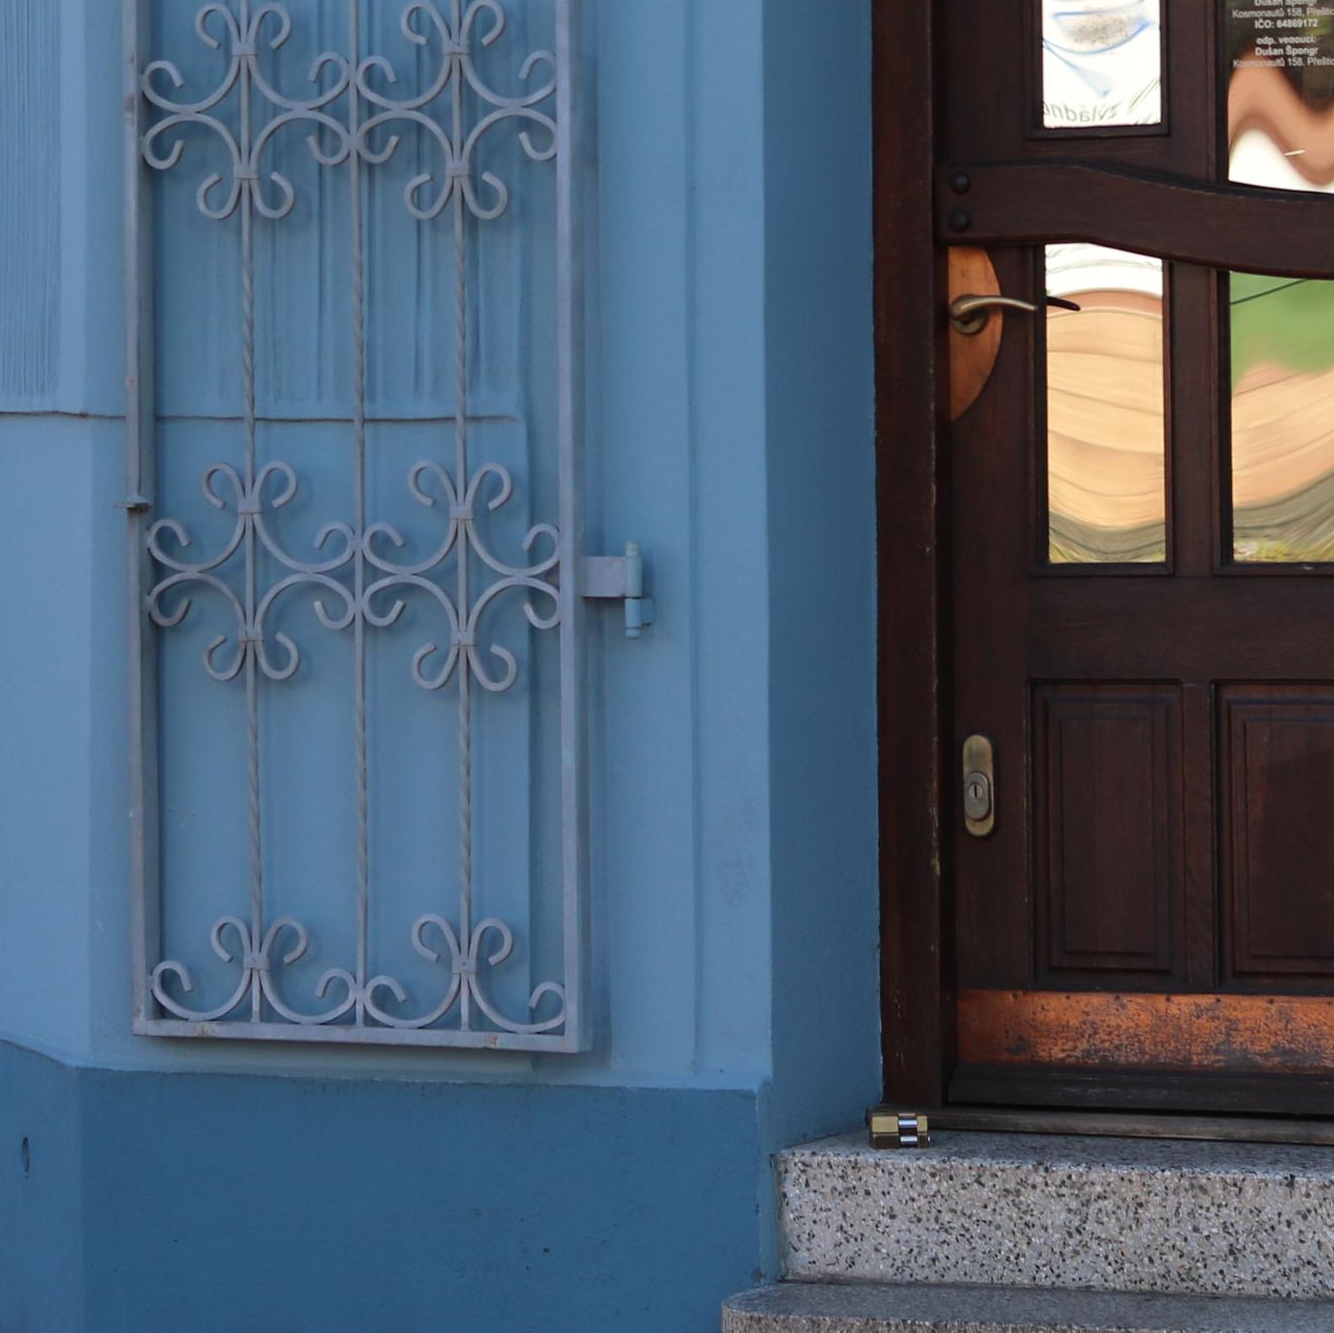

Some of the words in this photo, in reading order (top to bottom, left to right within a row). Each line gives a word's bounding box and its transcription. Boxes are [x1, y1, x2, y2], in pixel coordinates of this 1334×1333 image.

[1232, 8, 1284, 18] Kosmonautů
[1254, 19, 1275, 29] IČO:
[1255, 47, 1284, 56] Dušan
[1285, 46, 1319, 56] Špongr
